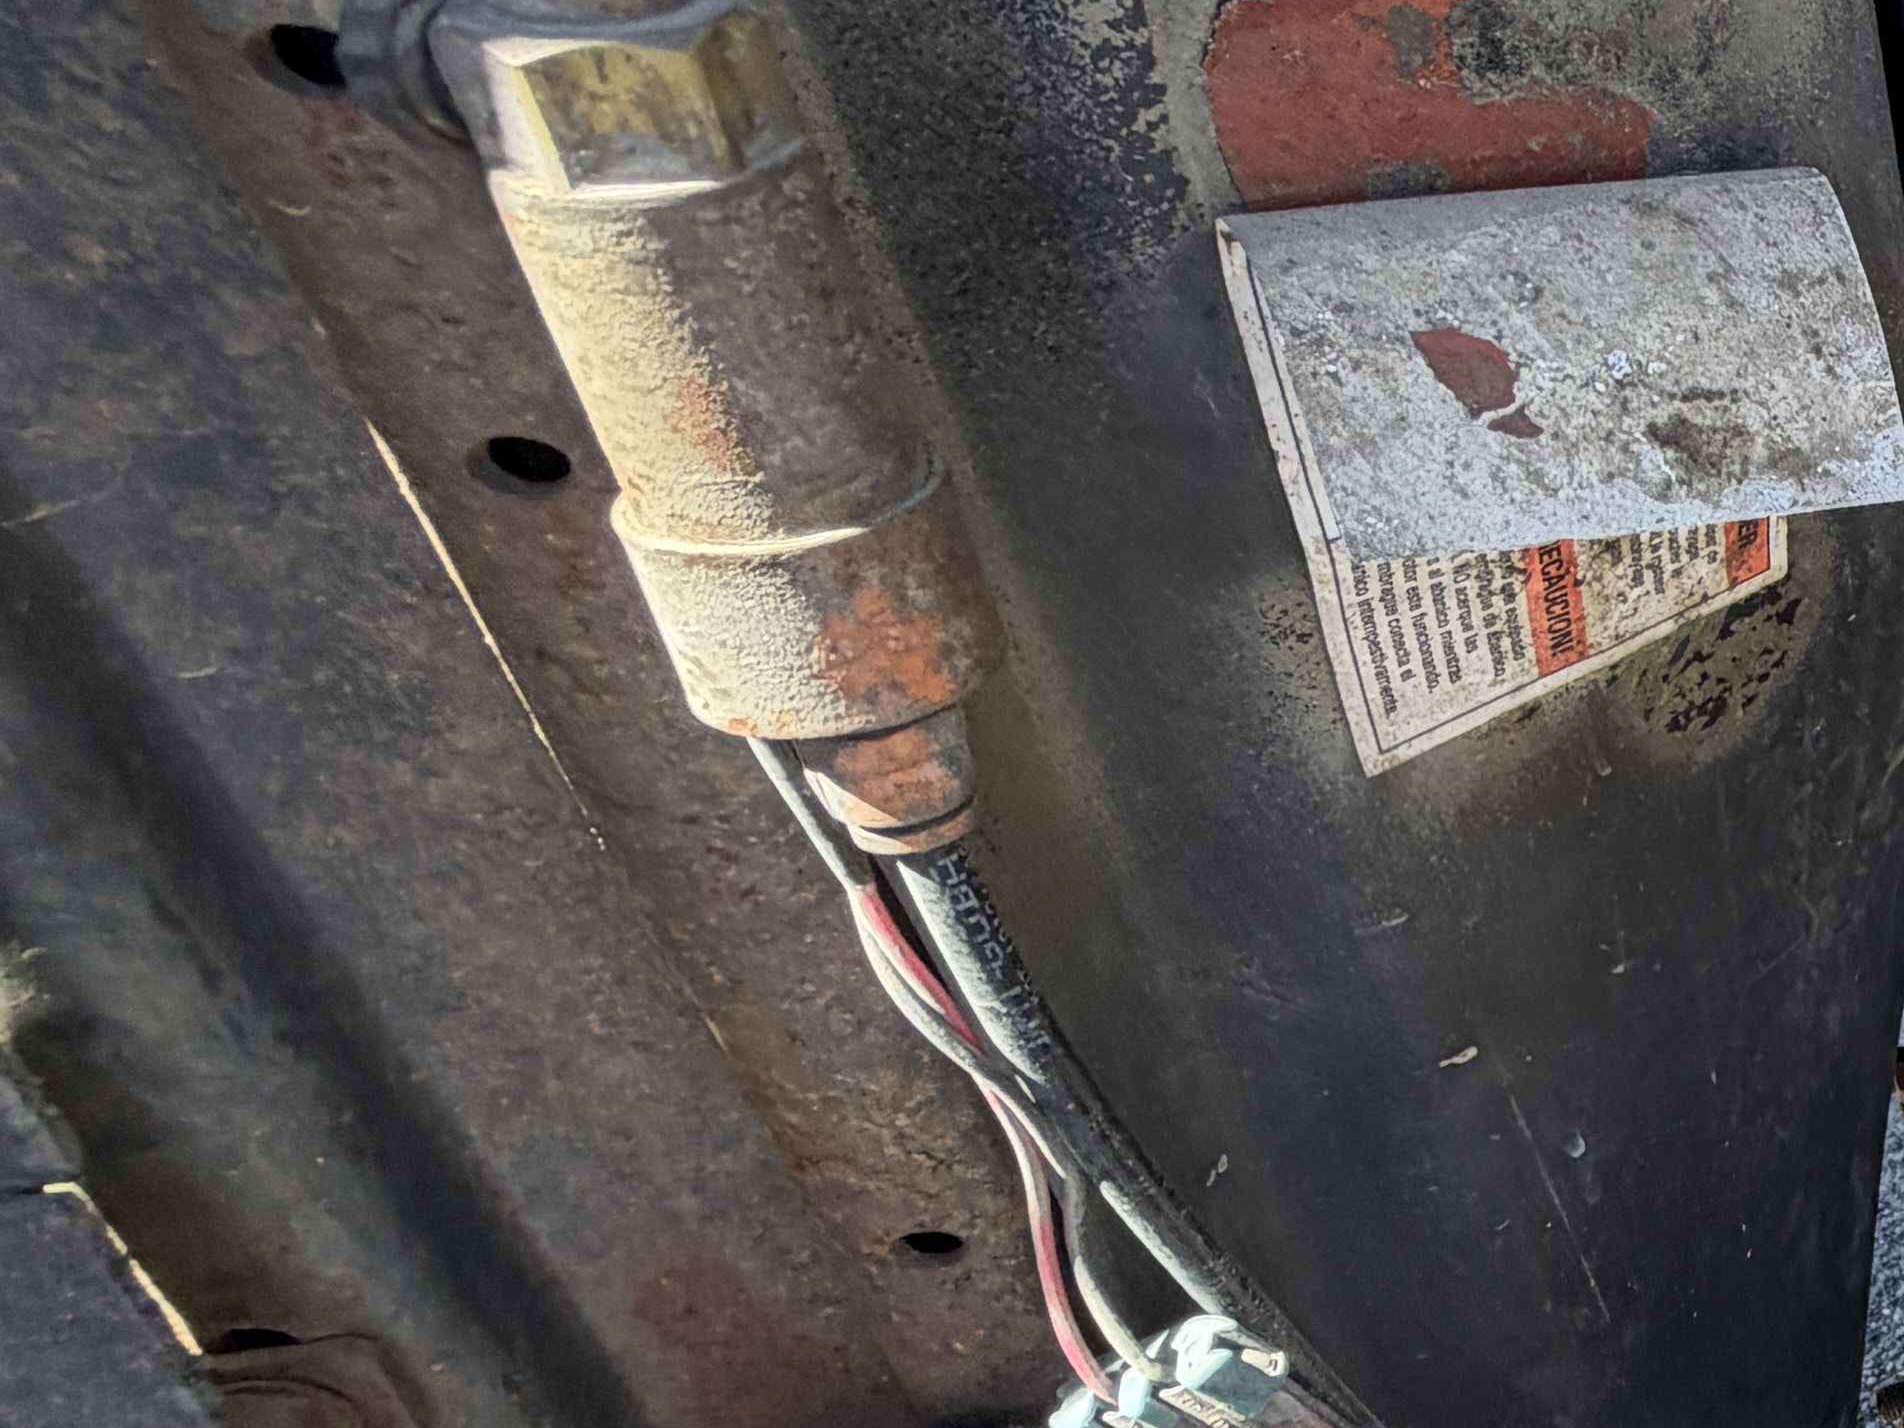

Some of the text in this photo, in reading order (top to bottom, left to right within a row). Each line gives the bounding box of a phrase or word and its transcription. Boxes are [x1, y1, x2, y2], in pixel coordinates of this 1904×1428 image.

[1373, 562, 1416, 683] mbrague conecta el
[1406, 585, 1423, 611] este
[1428, 568, 1463, 685] al abanico mientras
[1452, 586, 1474, 632] acerque
[1464, 633, 1480, 653] las
[1356, 597, 1398, 718] intempestivamente.
[1411, 612, 1442, 694] funcionando.
